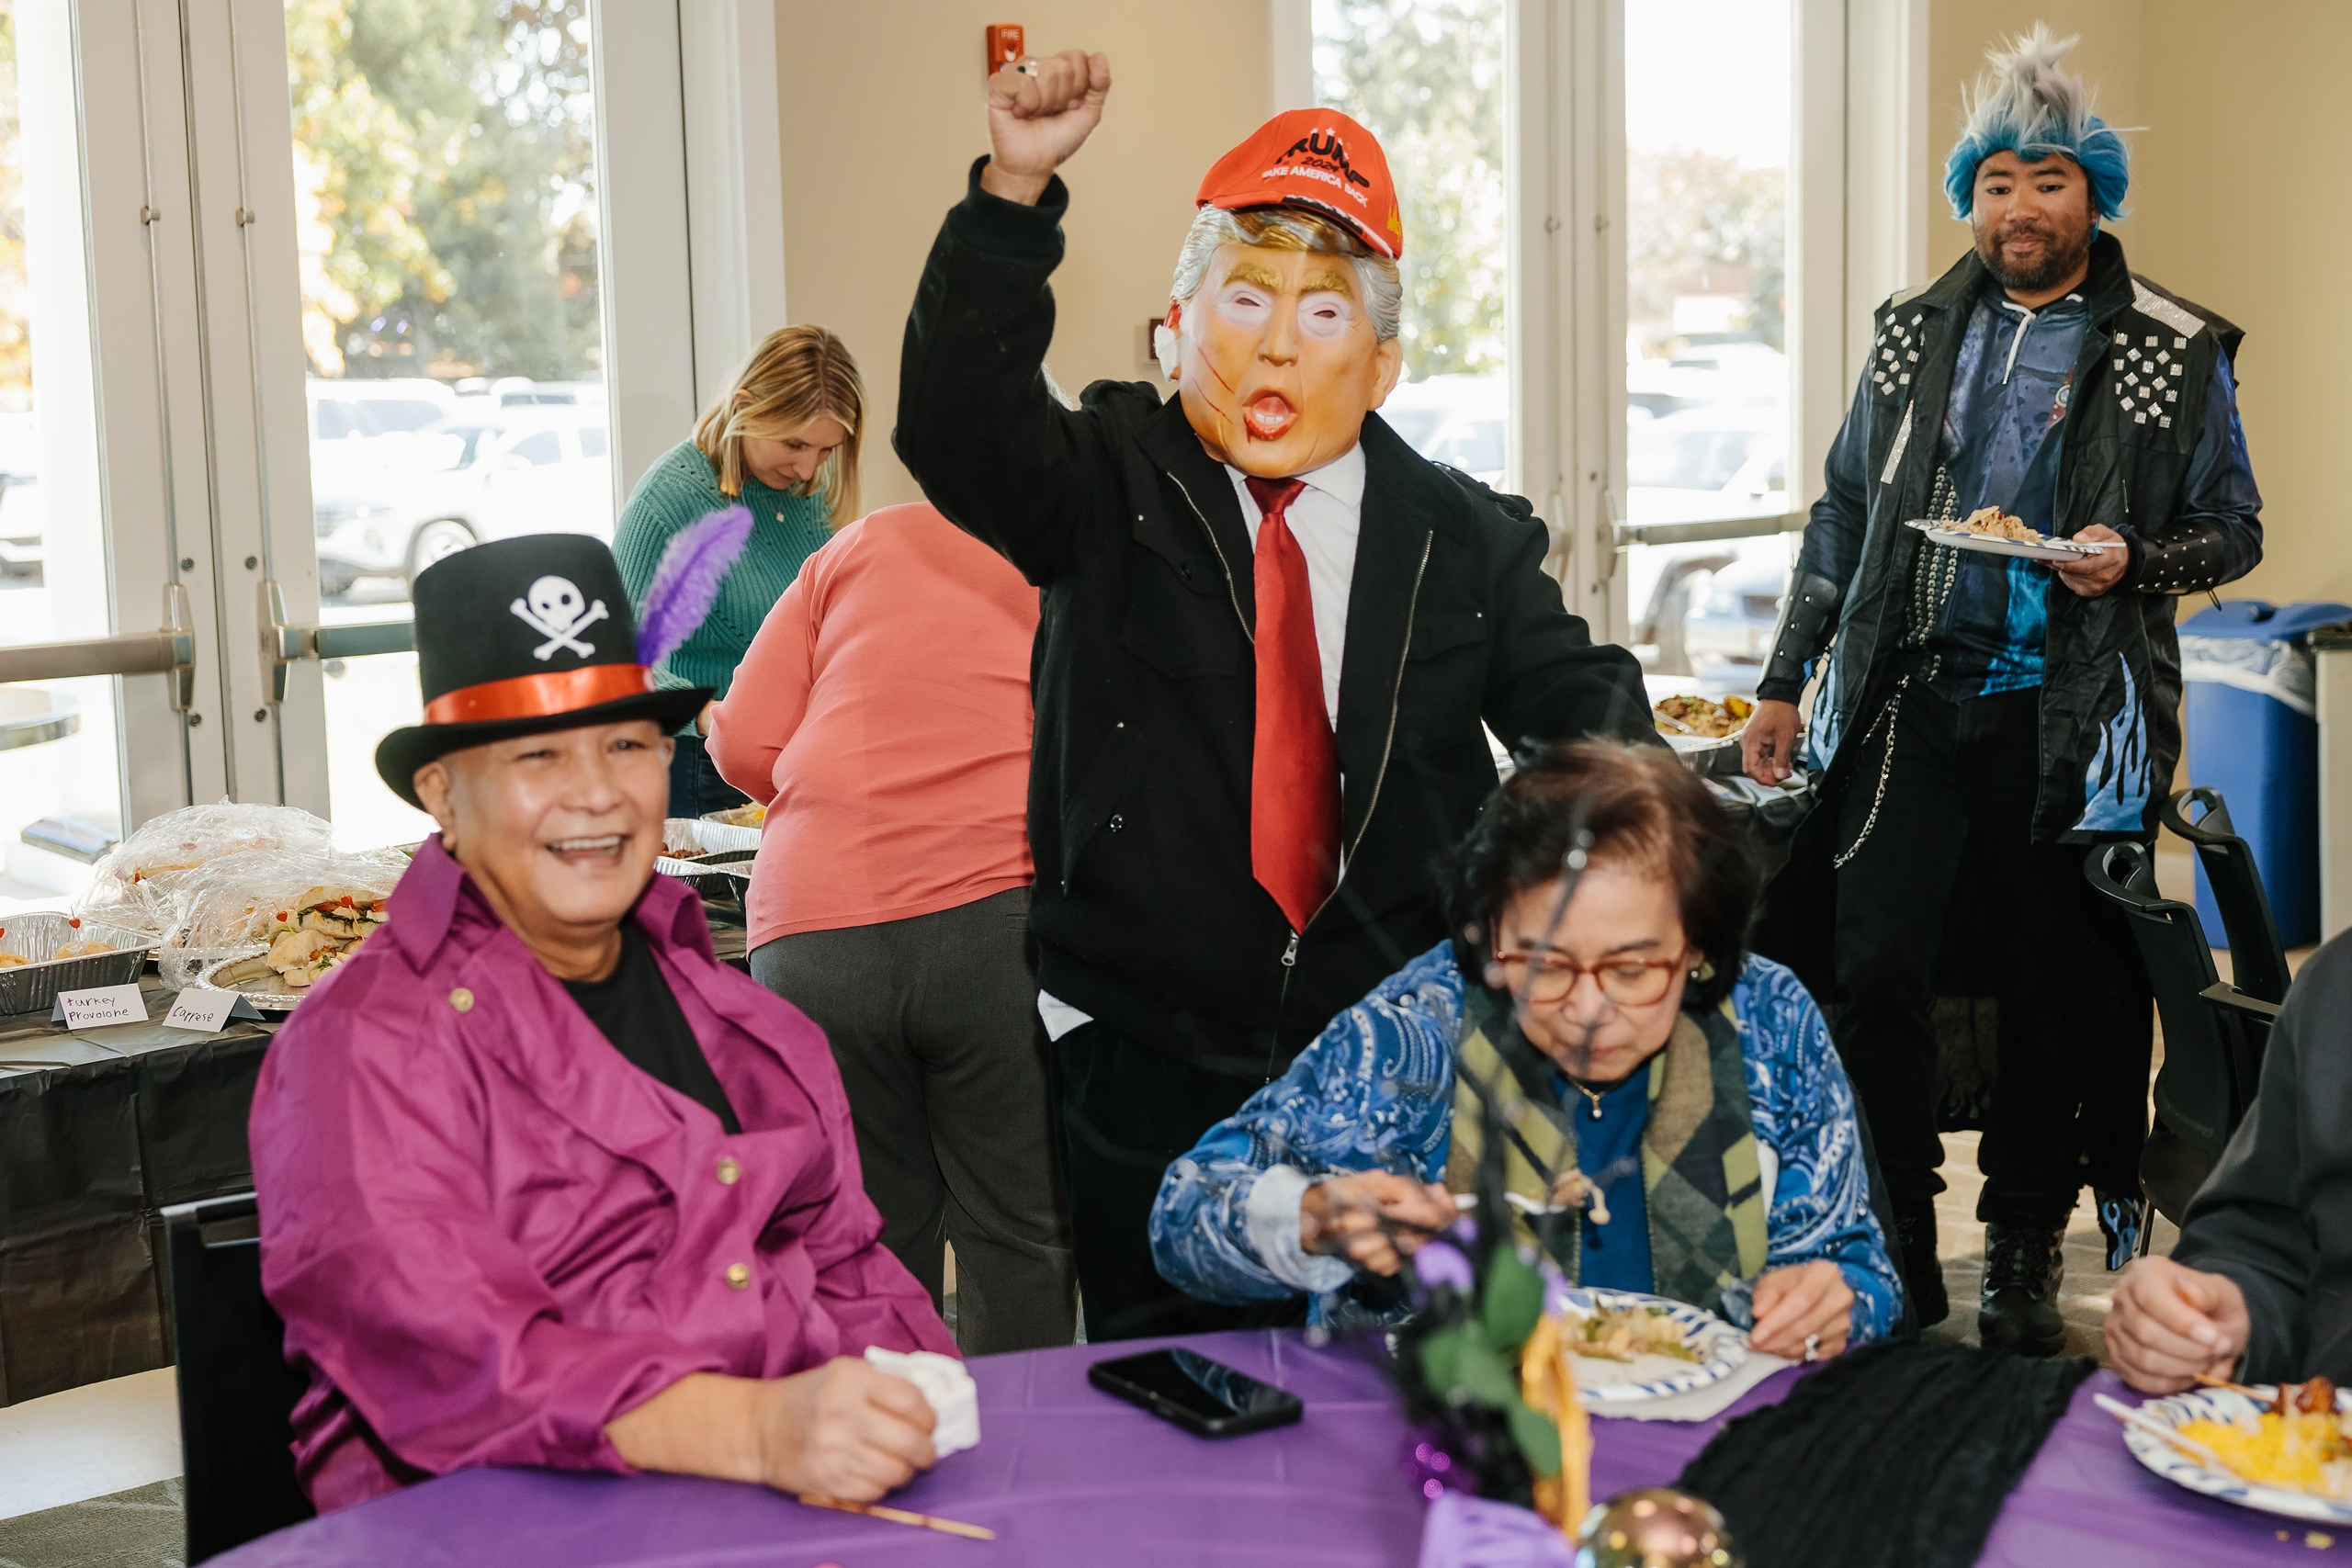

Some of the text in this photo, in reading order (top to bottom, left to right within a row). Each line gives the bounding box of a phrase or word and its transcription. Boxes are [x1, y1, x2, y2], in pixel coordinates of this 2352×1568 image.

[1301, 156, 1340, 173] 2024
[1290, 165, 1341, 188] AMERICA
[1344, 183, 1368, 208] BACK
